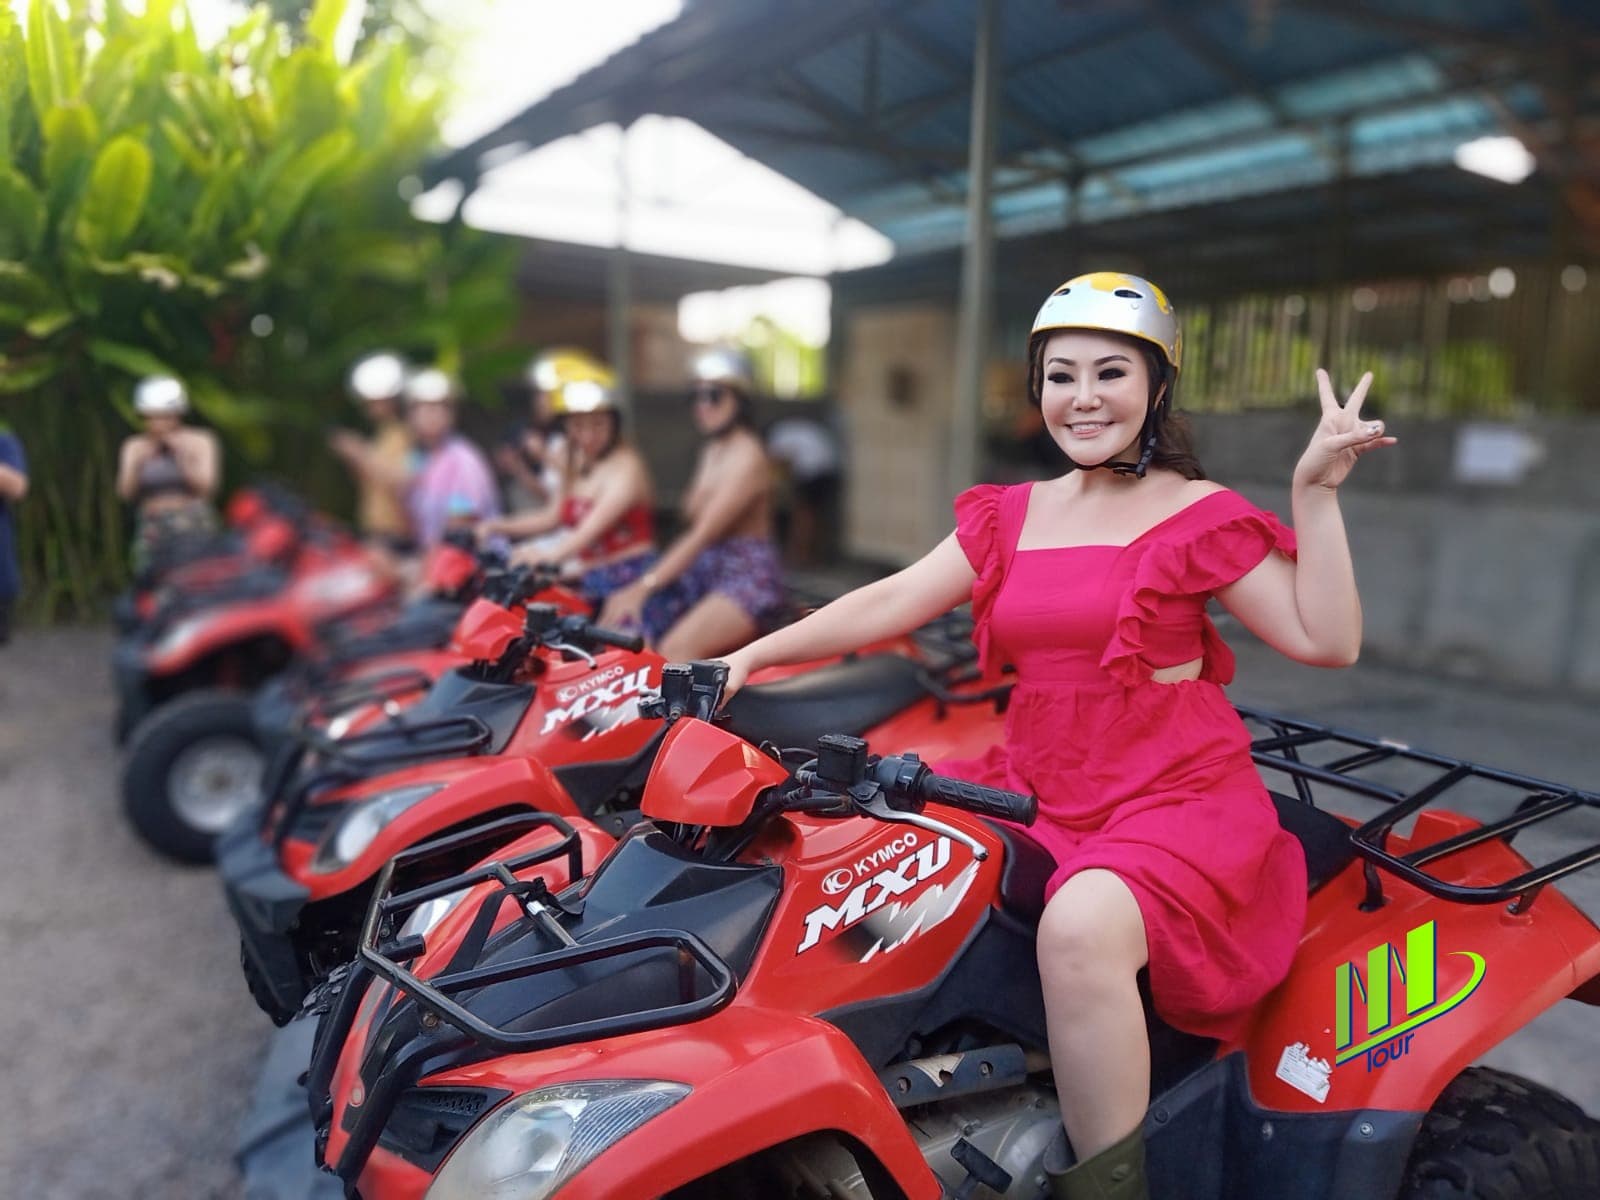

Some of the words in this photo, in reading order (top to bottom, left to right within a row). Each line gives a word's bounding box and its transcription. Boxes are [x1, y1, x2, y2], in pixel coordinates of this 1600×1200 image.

[579, 665, 625, 692] KYMCO
[853, 832, 918, 877] KYMCO
[797, 836, 951, 954] MXU
